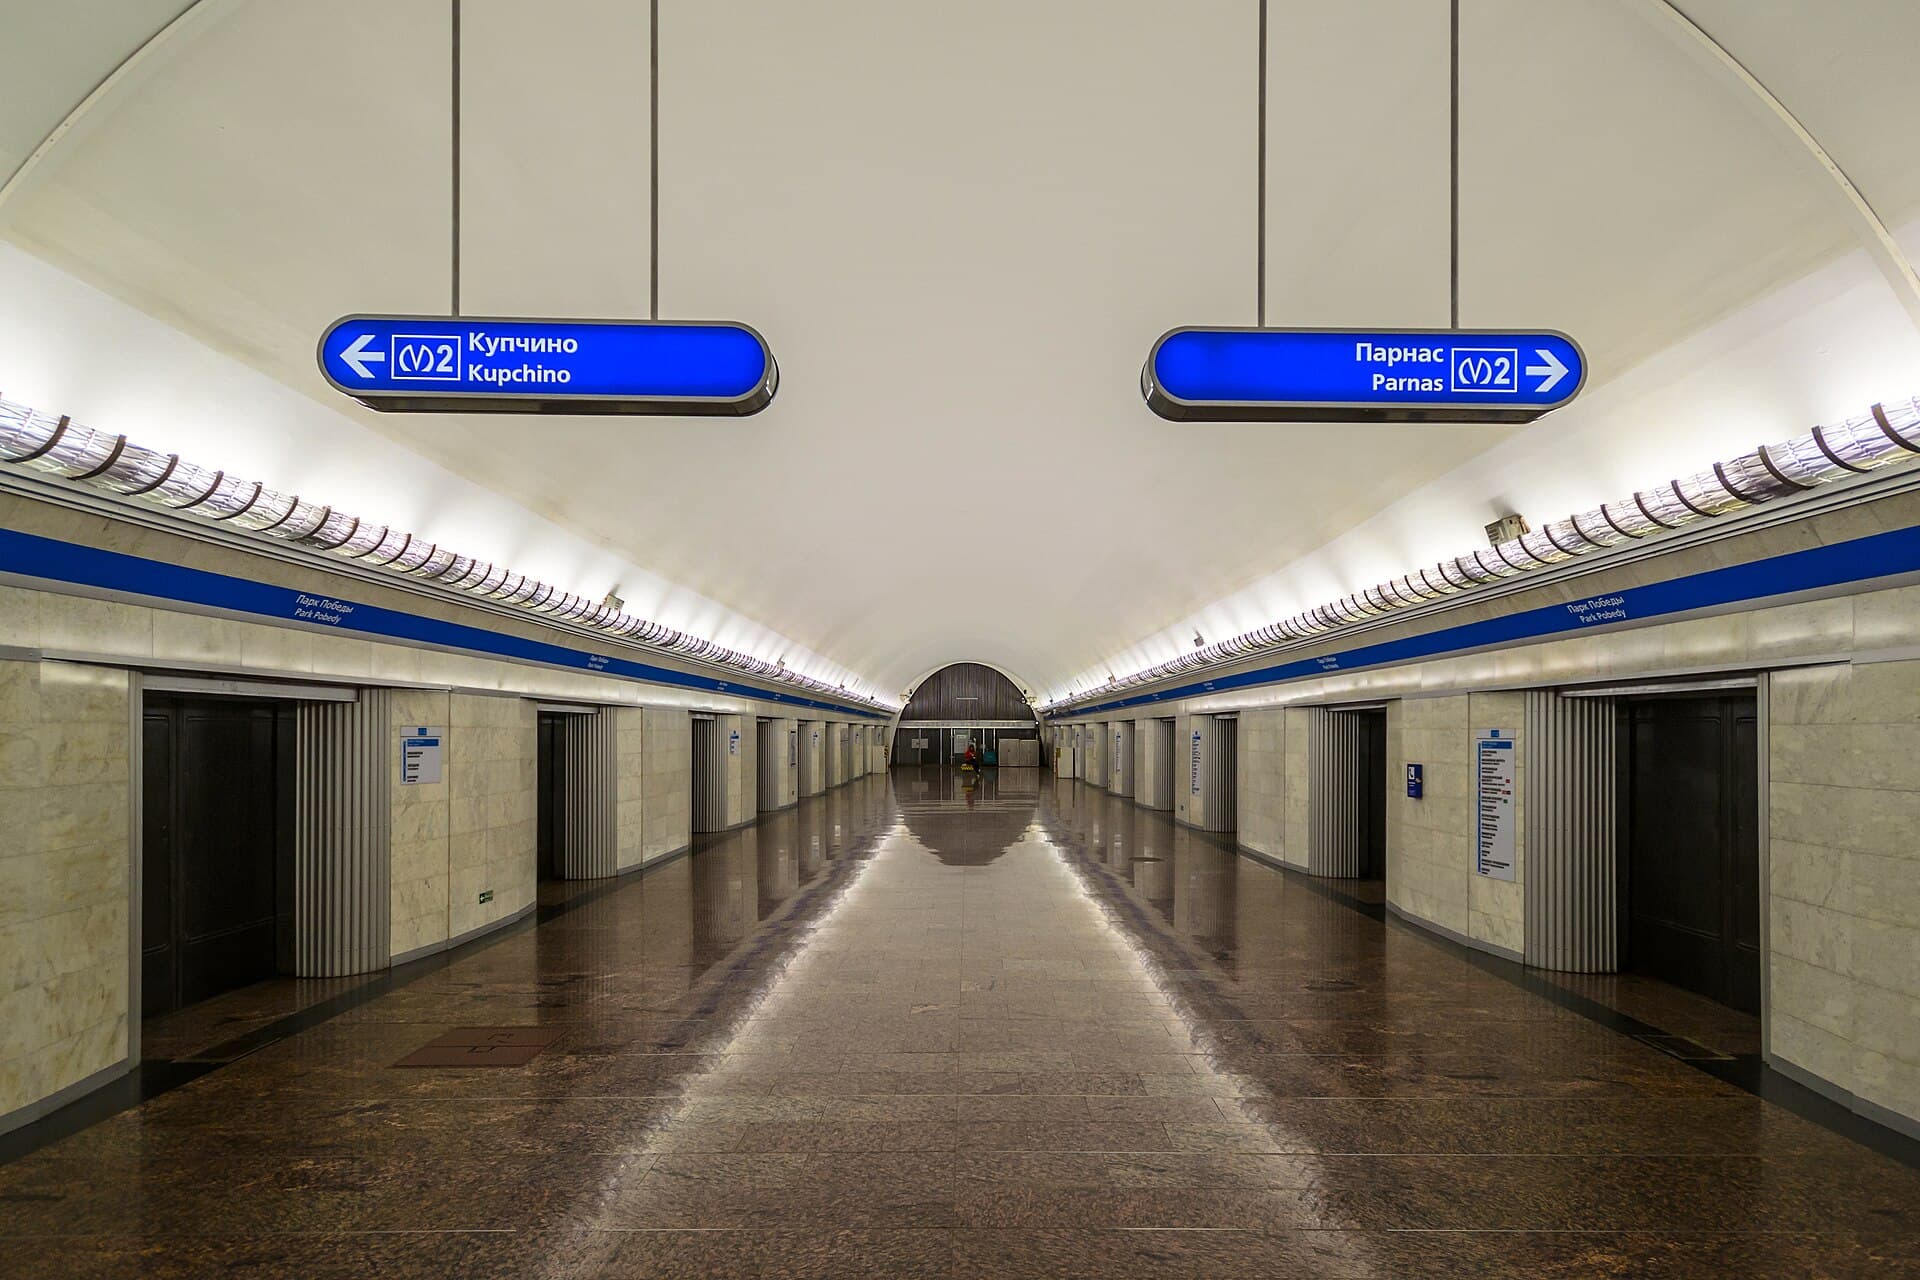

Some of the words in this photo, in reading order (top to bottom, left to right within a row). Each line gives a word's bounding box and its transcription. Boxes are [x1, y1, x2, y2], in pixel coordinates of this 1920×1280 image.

[468, 332, 578, 357] Купчино
[1356, 343, 1444, 367] Парнас
[468, 364, 571, 386] Kupchino
[1373, 374, 1443, 392] Parnas
[296, 595, 319, 607] Парк
[320, 600, 354, 613] Победы
[1567, 604, 1589, 614] Парк
[1588, 597, 1625, 609] Победы
[294, 608, 313, 618] Park
[313, 612, 341, 624] Pobedy
[1579, 614, 1597, 623] Park
[1597, 609, 1626, 619] Pobedy
